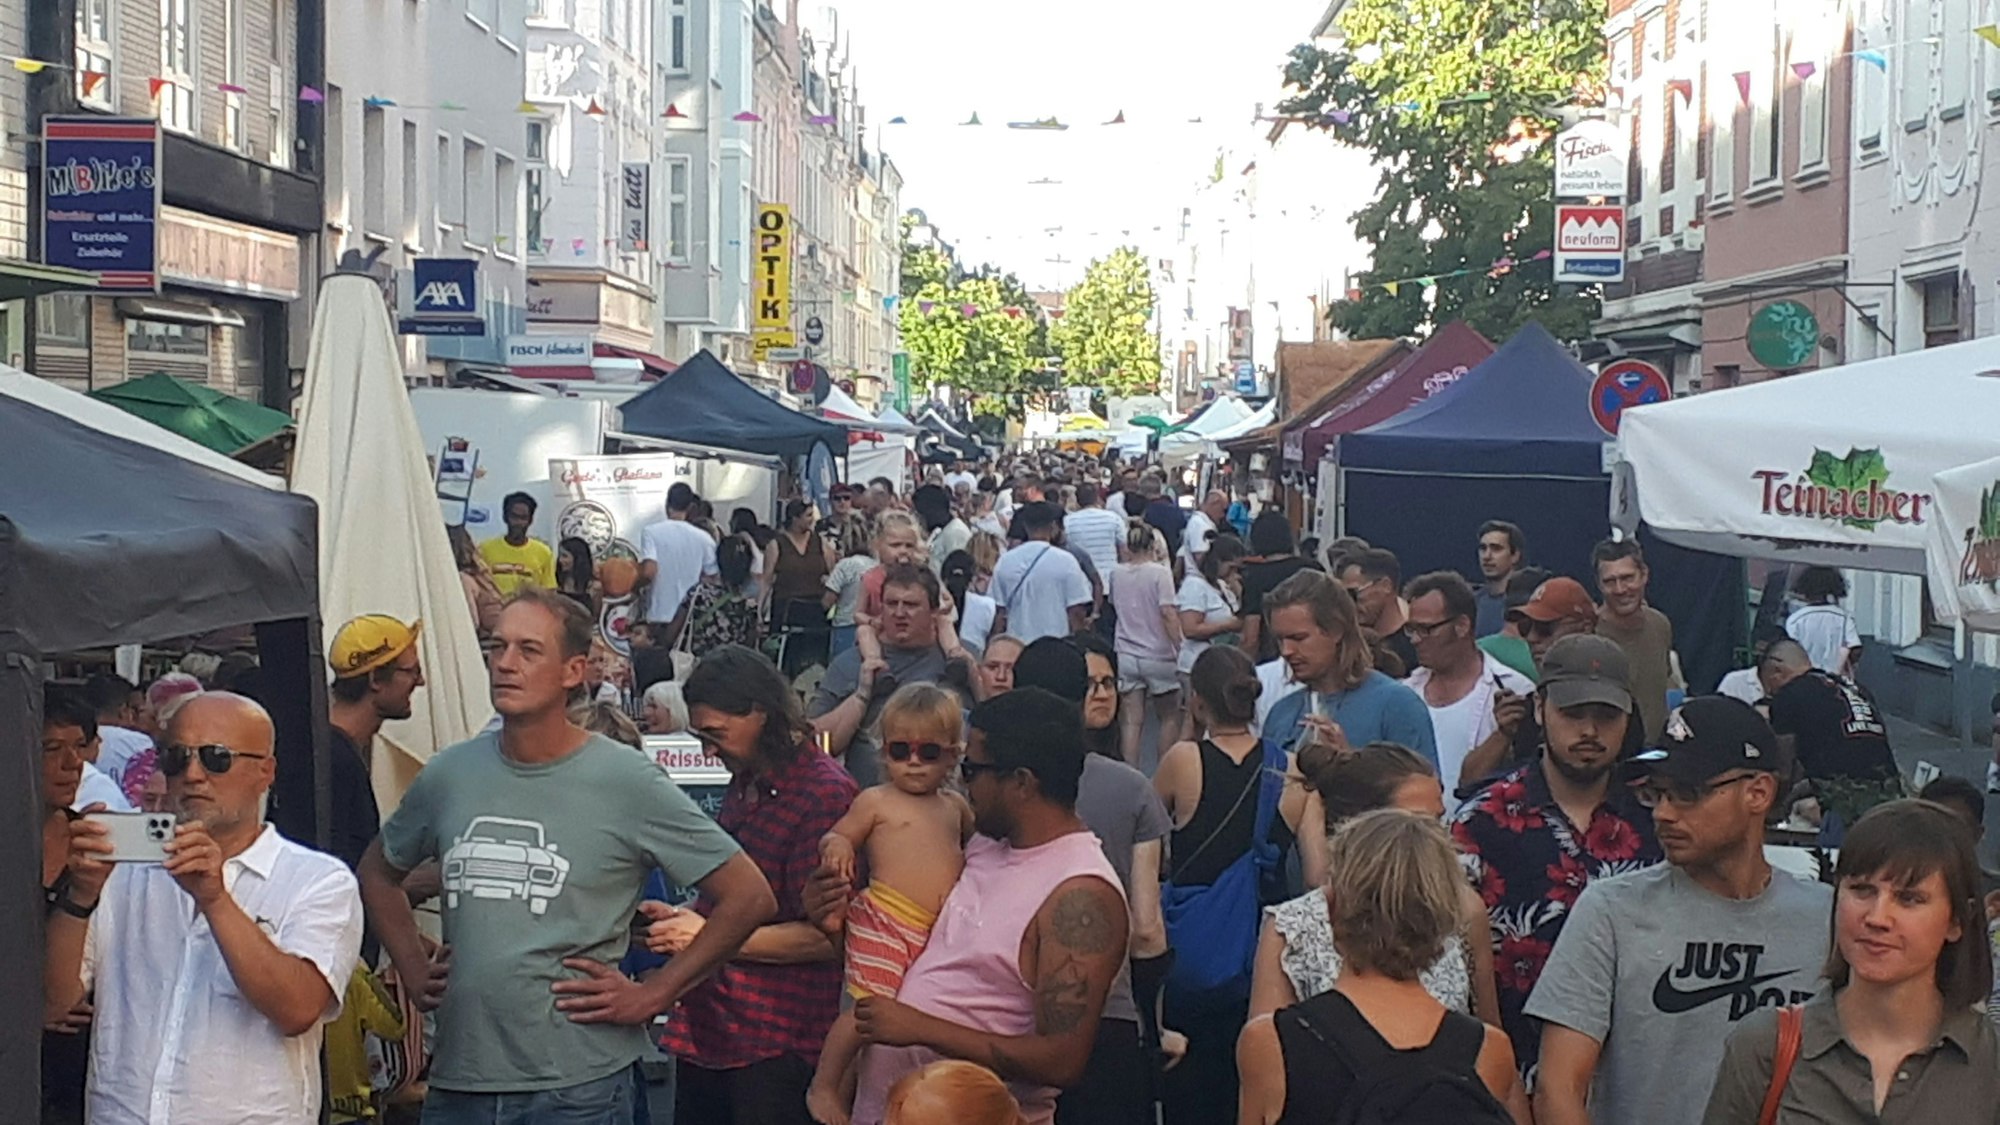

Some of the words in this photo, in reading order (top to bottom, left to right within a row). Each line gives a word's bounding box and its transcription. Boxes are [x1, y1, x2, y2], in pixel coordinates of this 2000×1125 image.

[1597, 180, 1623, 190] leben
[1564, 232, 1616, 246] neuform
[759, 210, 784, 319] OPTIK
[414, 281, 466, 306] AXA
[1751, 469, 1932, 526] Teinacher
[1675, 942, 1765, 981] JUST
